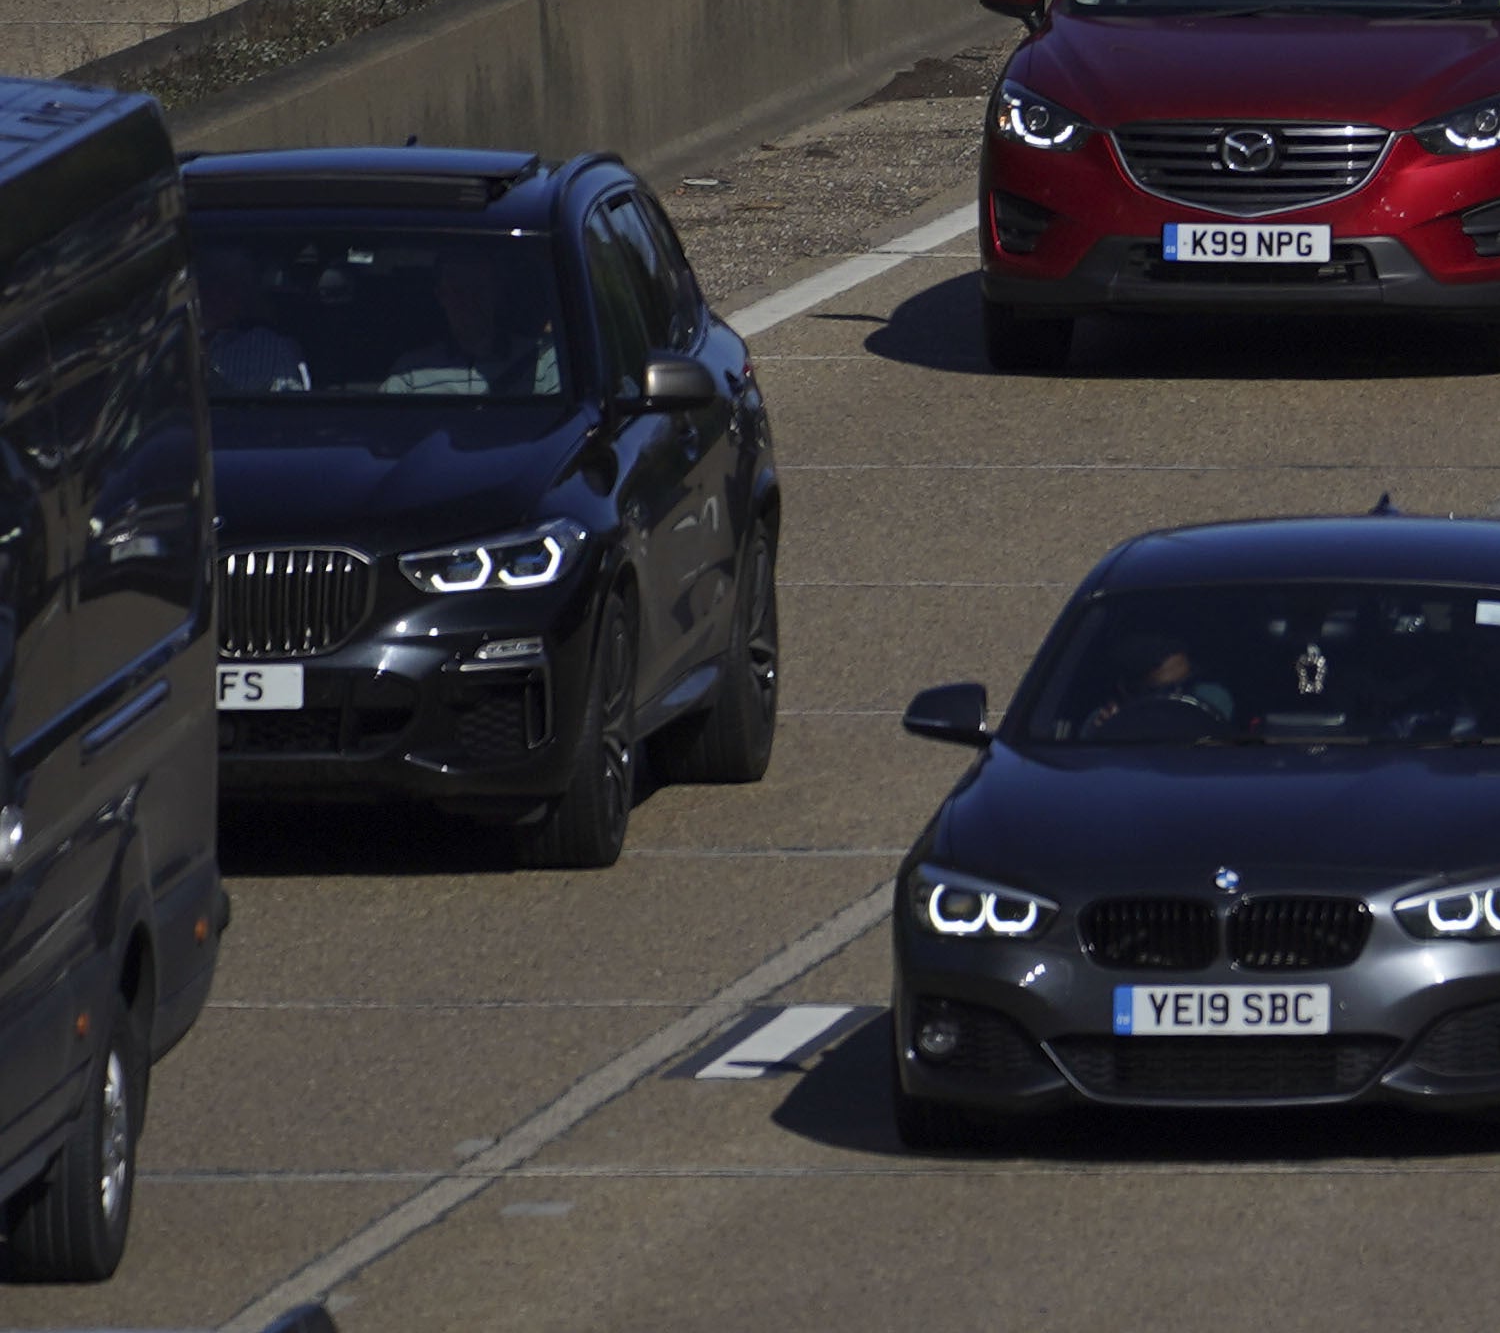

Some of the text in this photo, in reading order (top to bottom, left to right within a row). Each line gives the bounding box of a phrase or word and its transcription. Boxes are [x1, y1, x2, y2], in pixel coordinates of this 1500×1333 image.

[1191, 231, 1248, 256] K99
[1257, 232, 1313, 256] NPG
[1149, 992, 1230, 1025] YE19
[1241, 992, 1315, 1025] SBC
